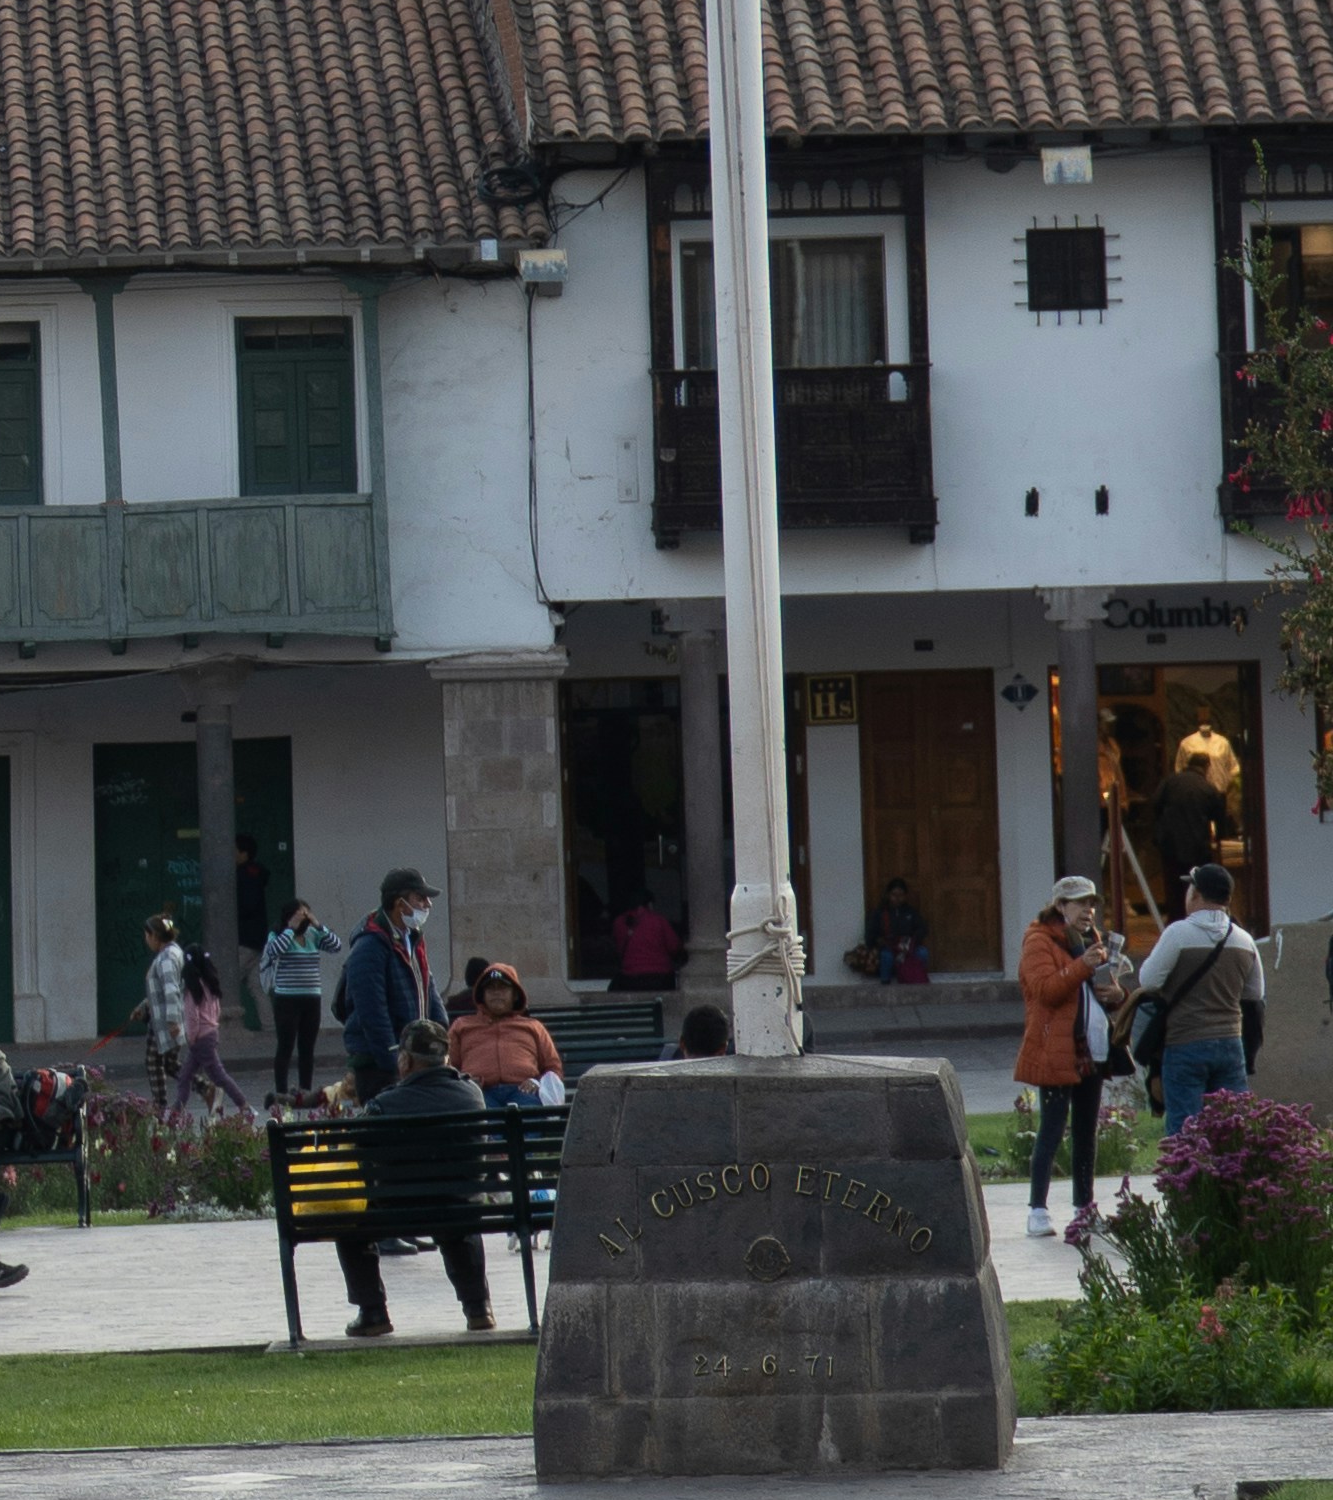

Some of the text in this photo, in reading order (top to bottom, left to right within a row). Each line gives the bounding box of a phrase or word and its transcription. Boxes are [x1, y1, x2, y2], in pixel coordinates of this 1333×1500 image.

[1102, 597, 1249, 629] Columbia
[598, 1162, 933, 1260] AL CUSCO ETERNO
